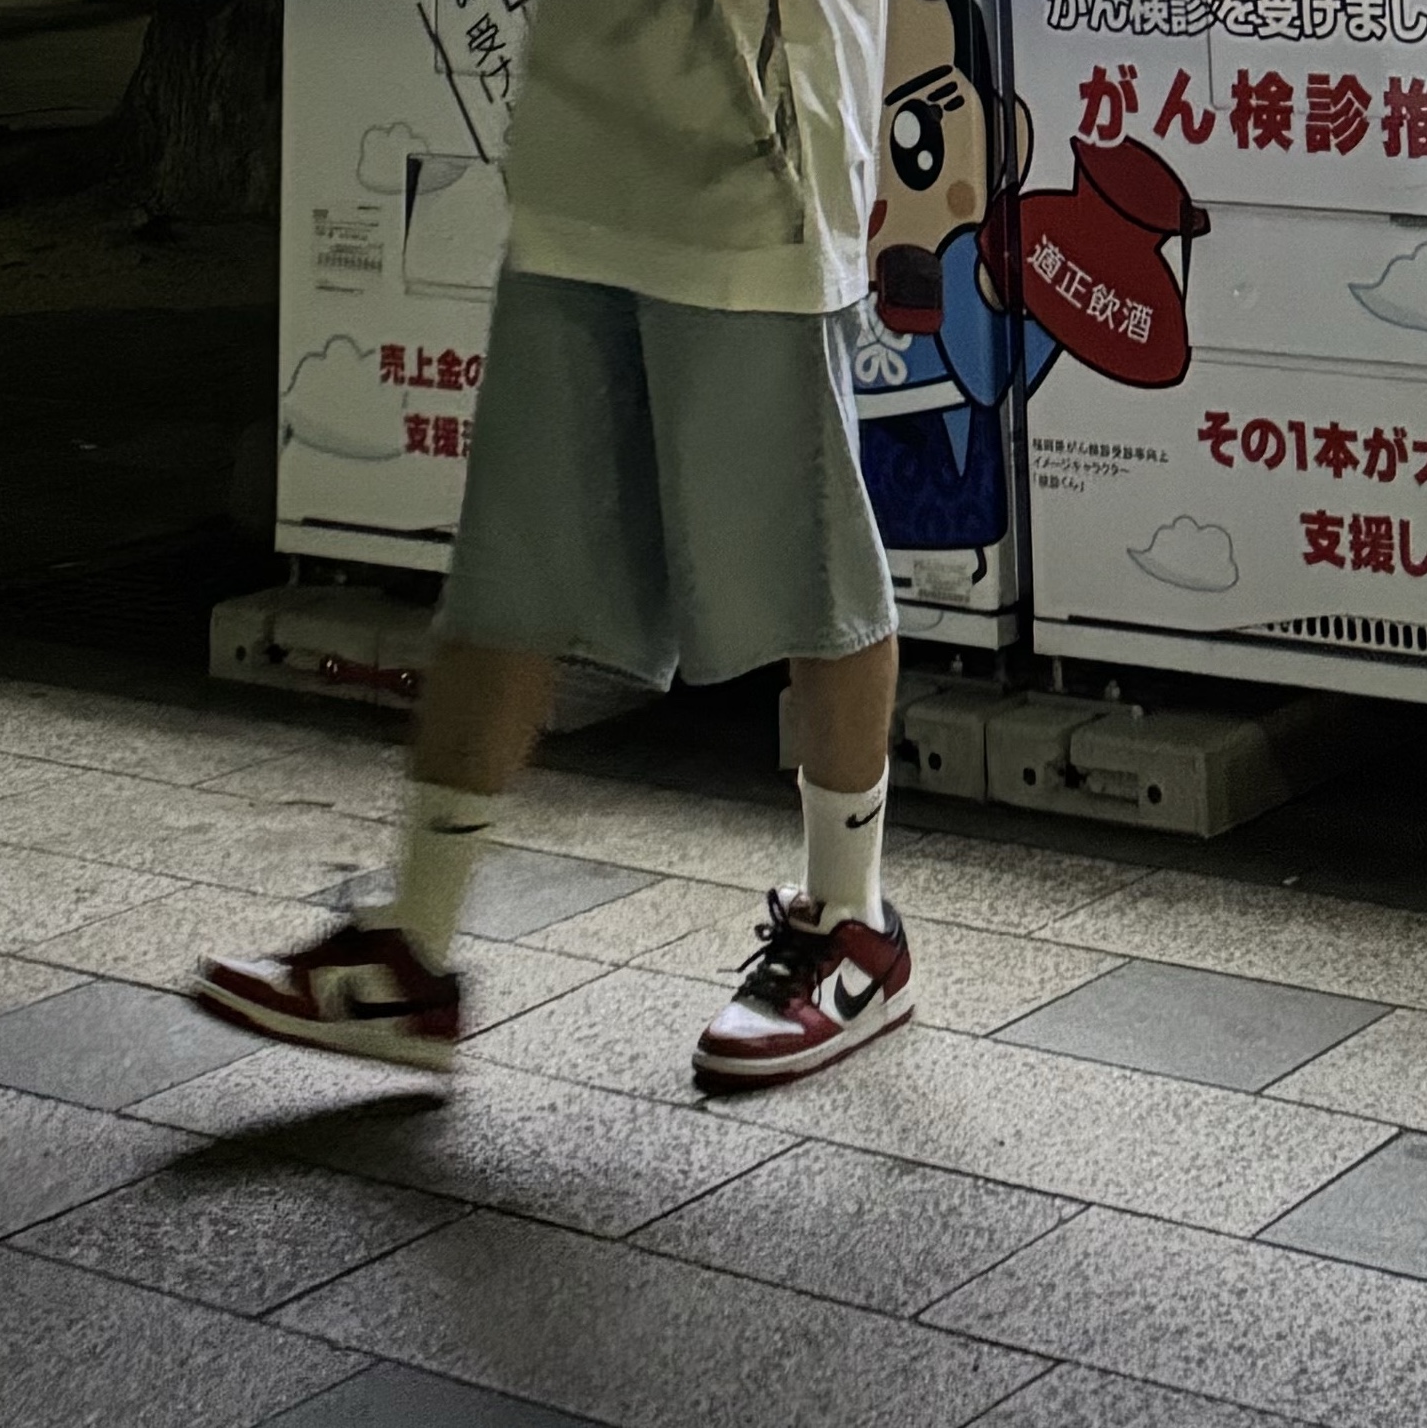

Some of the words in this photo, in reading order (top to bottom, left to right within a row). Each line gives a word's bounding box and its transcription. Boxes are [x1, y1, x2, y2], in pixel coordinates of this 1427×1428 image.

[467, 12, 515, 113] 受け
[1026, 235, 1153, 343] 適正飲酒
[380, 344, 483, 390] 売上金の
